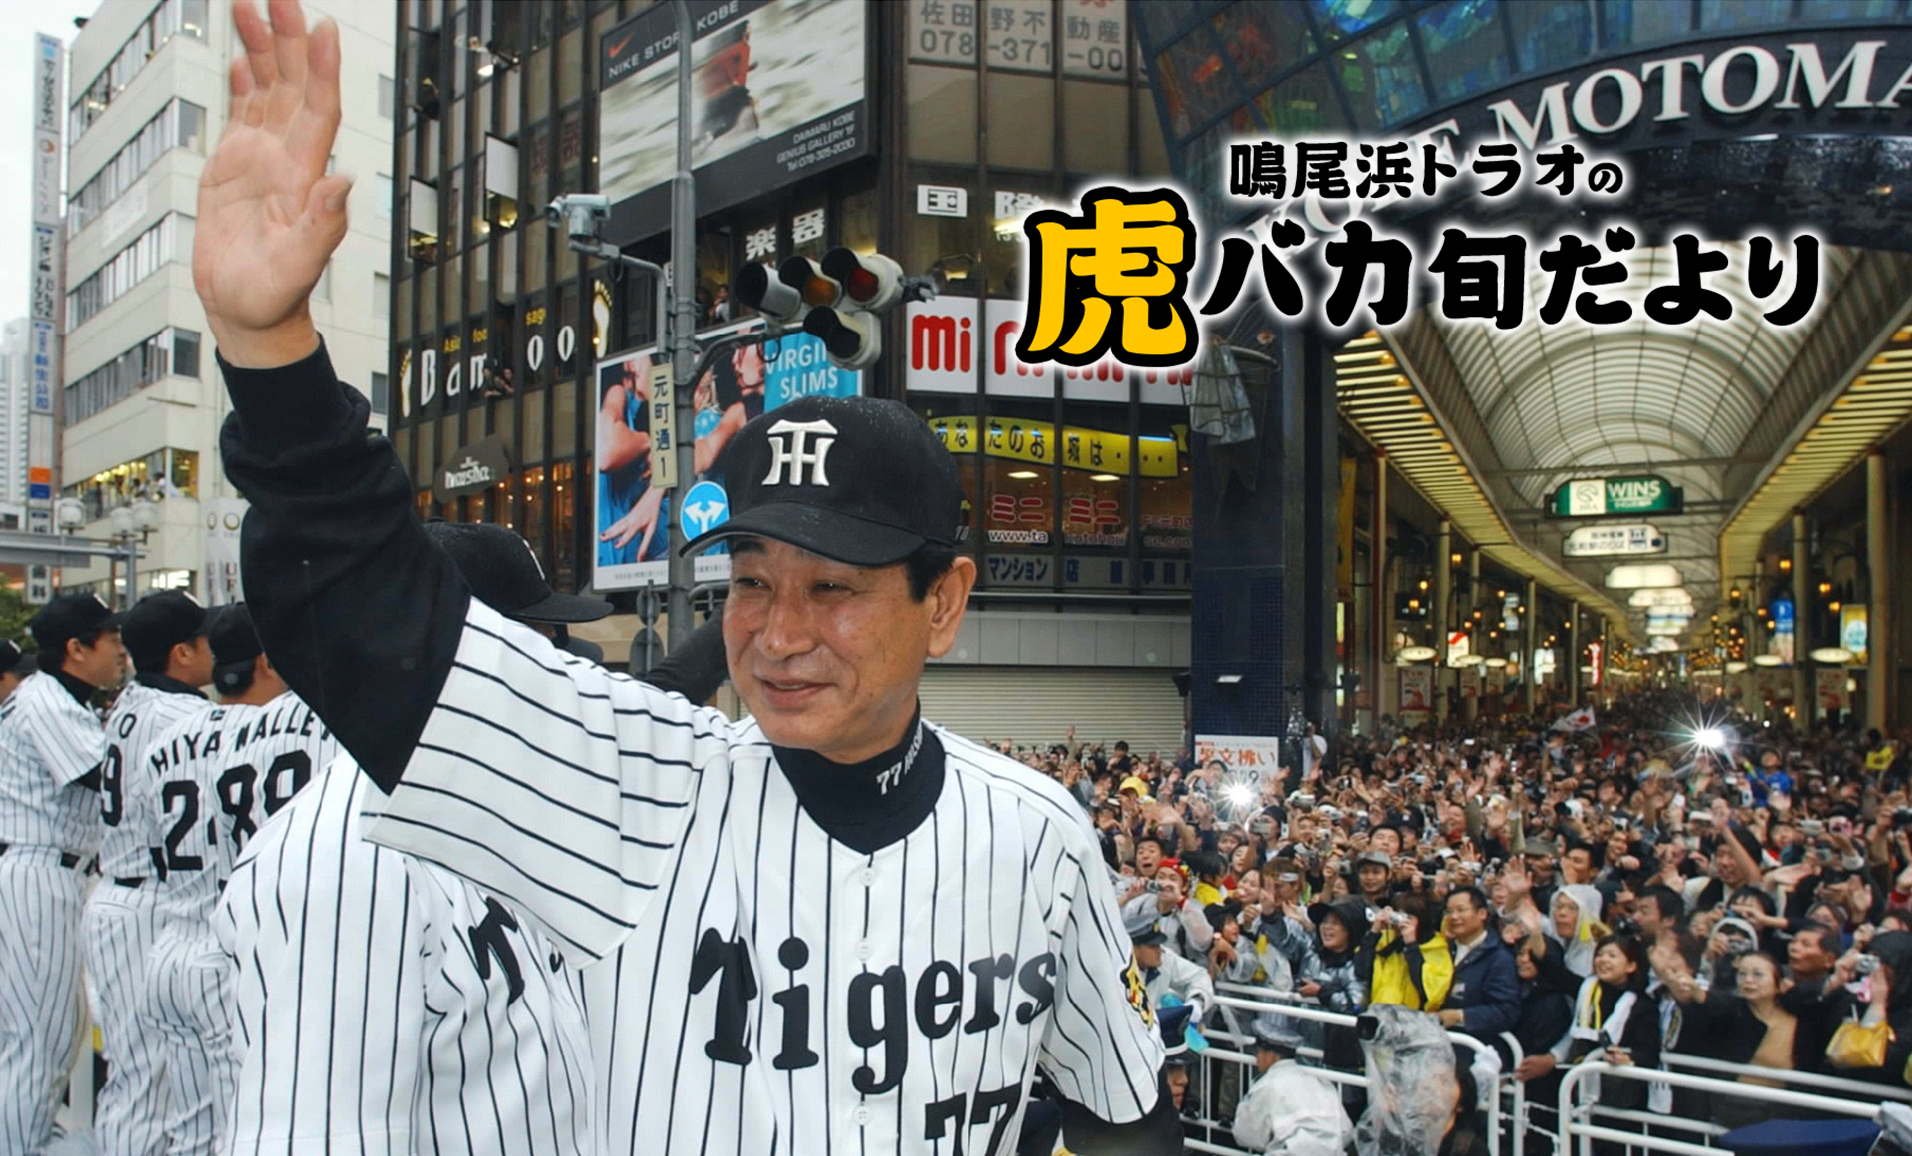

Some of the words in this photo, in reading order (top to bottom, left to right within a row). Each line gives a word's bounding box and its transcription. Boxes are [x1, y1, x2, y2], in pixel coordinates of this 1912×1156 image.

[608, 54, 640, 79] NIKE
[644, 31, 681, 59] STOR
[697, 0, 739, 32] KOBE
[421, 326, 575, 406] Bamoo
[780, 366, 839, 399] SLIMS
[1607, 480, 1661, 498] WINS
[988, 556, 1048, 582] マンション
[876, 761, 903, 796] 77
[688, 926, 1058, 1096] Tigers
[925, 1081, 1023, 1156] 77
